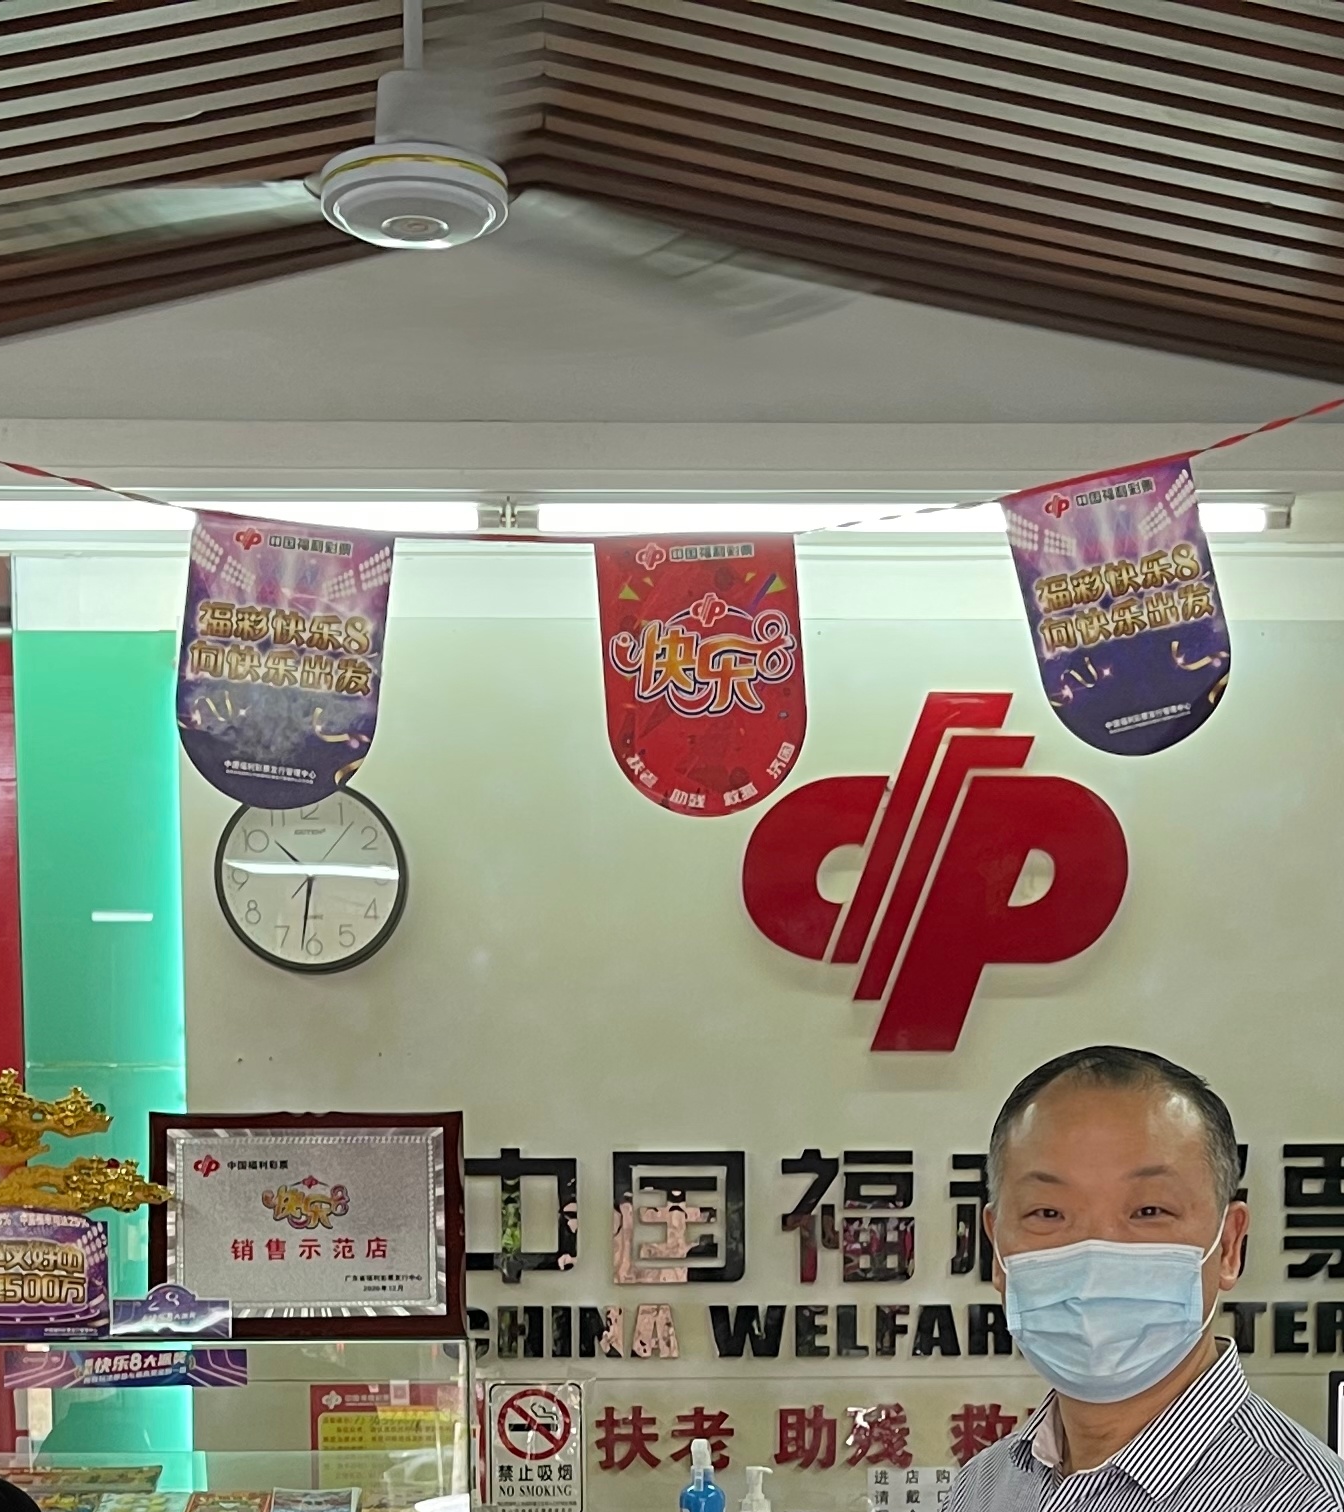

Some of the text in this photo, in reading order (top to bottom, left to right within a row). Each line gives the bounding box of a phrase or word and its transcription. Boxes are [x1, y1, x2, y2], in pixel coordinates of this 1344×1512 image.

[1035, 542, 1201, 614] 福彩快乐8
[199, 600, 371, 656] 福彩快乐8
[1038, 582, 1216, 655] 向快乐出发
[188, 639, 373, 697] 向快乐出发
[242, 827, 269, 853] 10
[360, 826, 378, 850] 2
[244, 899, 261, 925] 8
[363, 897, 380, 920] 4
[274, 926, 290, 948] 7
[305, 932, 323, 957] 6
[338, 924, 356, 948] 5
[231, 1236, 389, 1262] 销售示范店
[709, 1304, 1022, 1358] WELFAR
[595, 1406, 735, 1471] 扶老
[774, 1402, 914, 1468] 助残
[498, 1464, 573, 1482] 禁止吸烟
[498, 1485, 572, 1497] NO SMOKING
